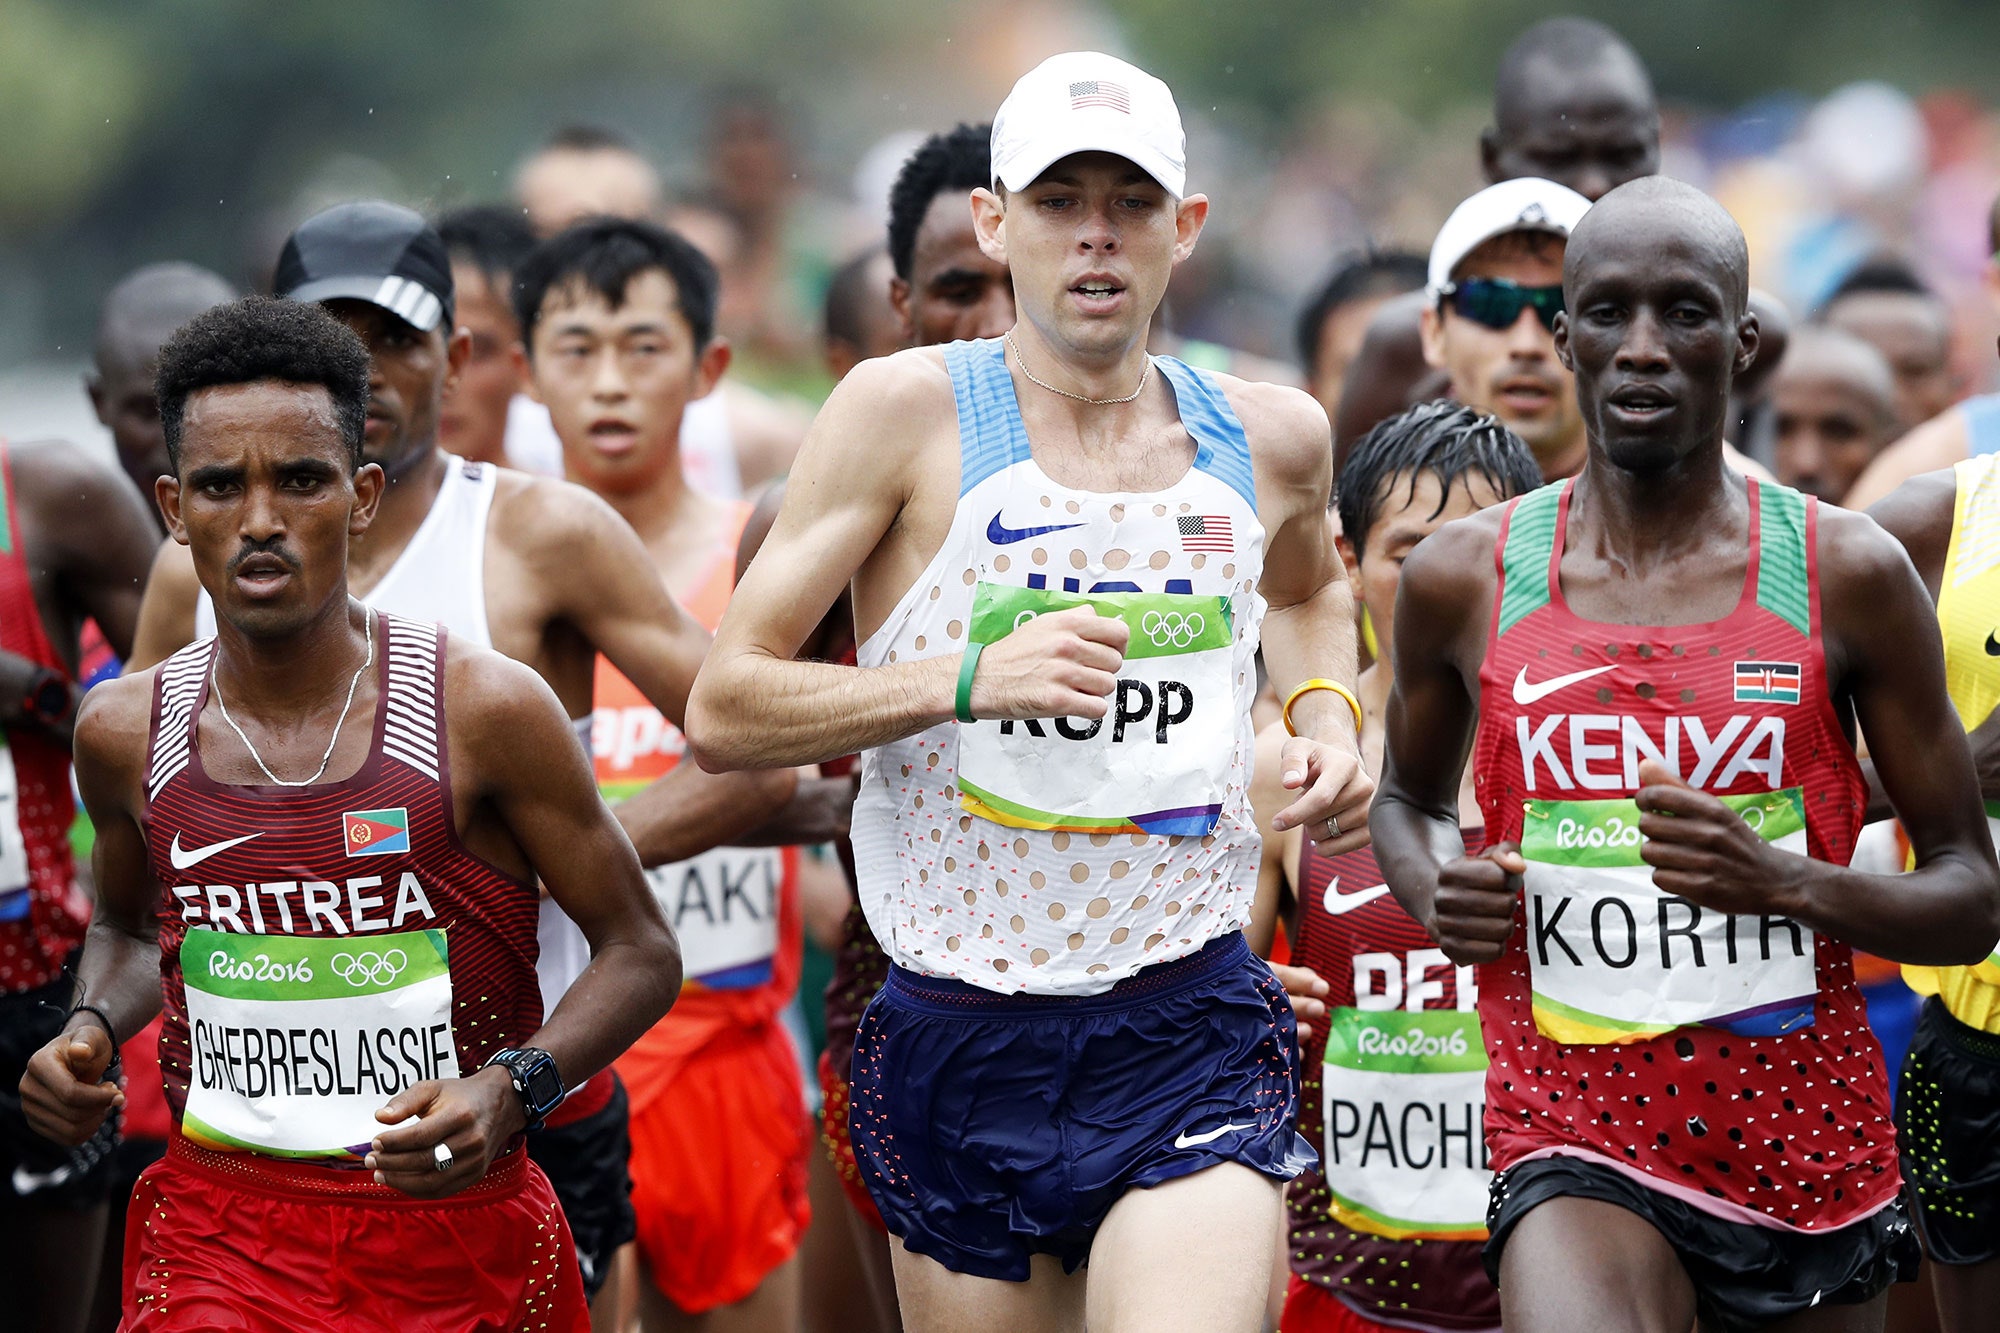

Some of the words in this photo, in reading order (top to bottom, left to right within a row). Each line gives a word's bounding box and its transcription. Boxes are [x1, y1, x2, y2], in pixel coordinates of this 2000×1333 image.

[1515, 714, 1785, 791] KENYA
[1556, 817, 1650, 848] Rio20
[171, 871, 436, 934] ERITREA
[653, 857, 776, 927] AKI
[1533, 894, 1805, 969] KORIR
[208, 950, 313, 983] Rio2016
[195, 1018, 450, 1098] GHEBRESLASSIE
[1357, 1026, 1468, 1056] Rio2016
